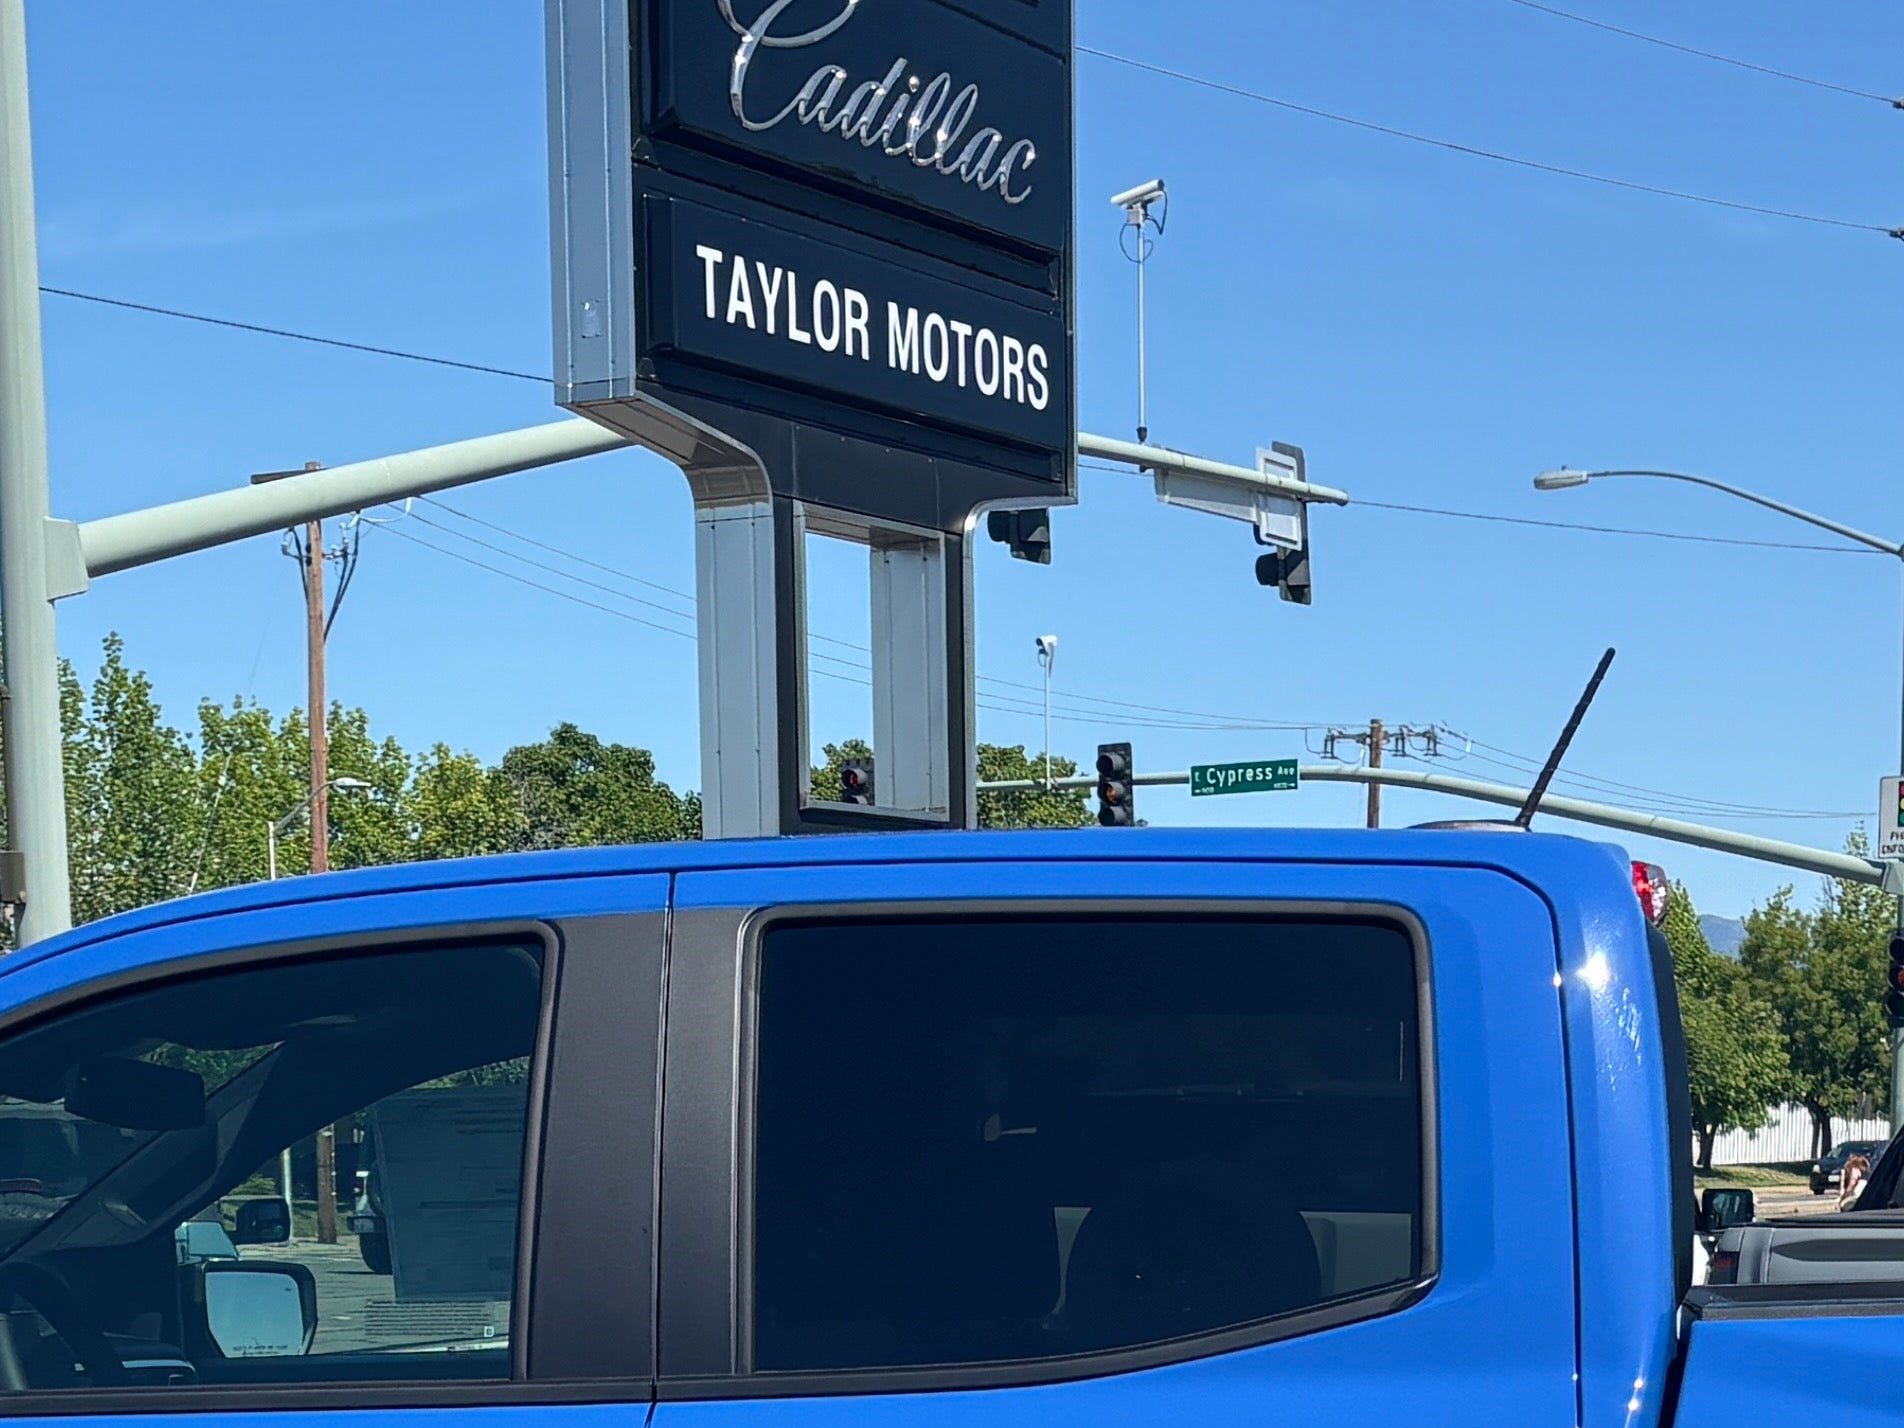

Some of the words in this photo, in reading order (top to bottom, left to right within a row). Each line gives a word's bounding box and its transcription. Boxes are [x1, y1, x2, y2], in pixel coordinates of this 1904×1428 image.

[717, 0, 1036, 204] Cadillac
[695, 244, 871, 362] TAYLOR
[887, 301, 1050, 411] MOTORS
[1206, 767, 1273, 787] Cypress
[1277, 765, 1295, 776] Ave
